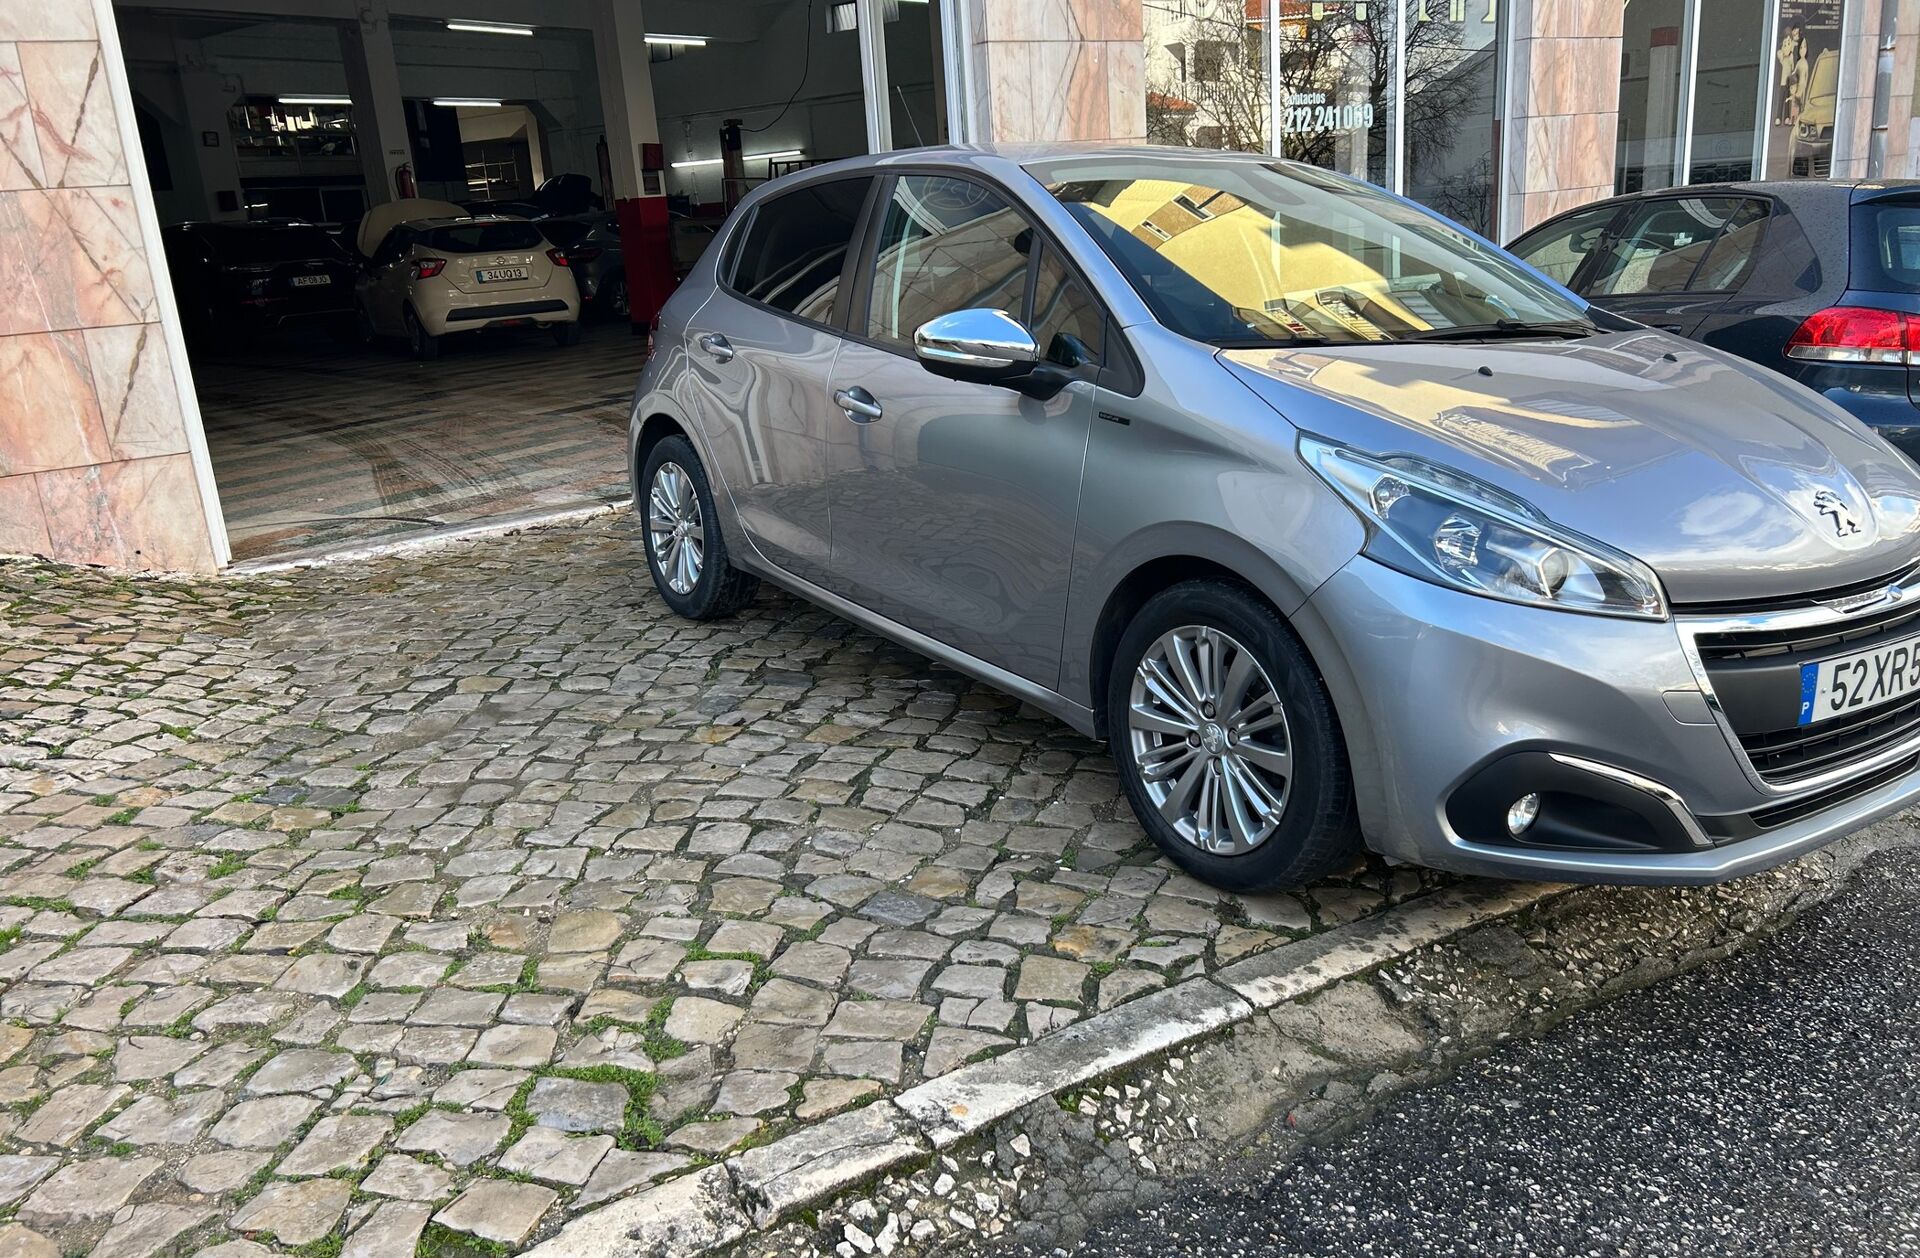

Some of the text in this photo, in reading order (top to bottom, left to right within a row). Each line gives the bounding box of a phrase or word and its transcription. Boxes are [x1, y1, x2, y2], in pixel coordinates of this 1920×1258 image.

[1284, 106, 1312, 133] 212
[1314, 105, 1341, 133] 241
[1801, 701, 1810, 715] P
